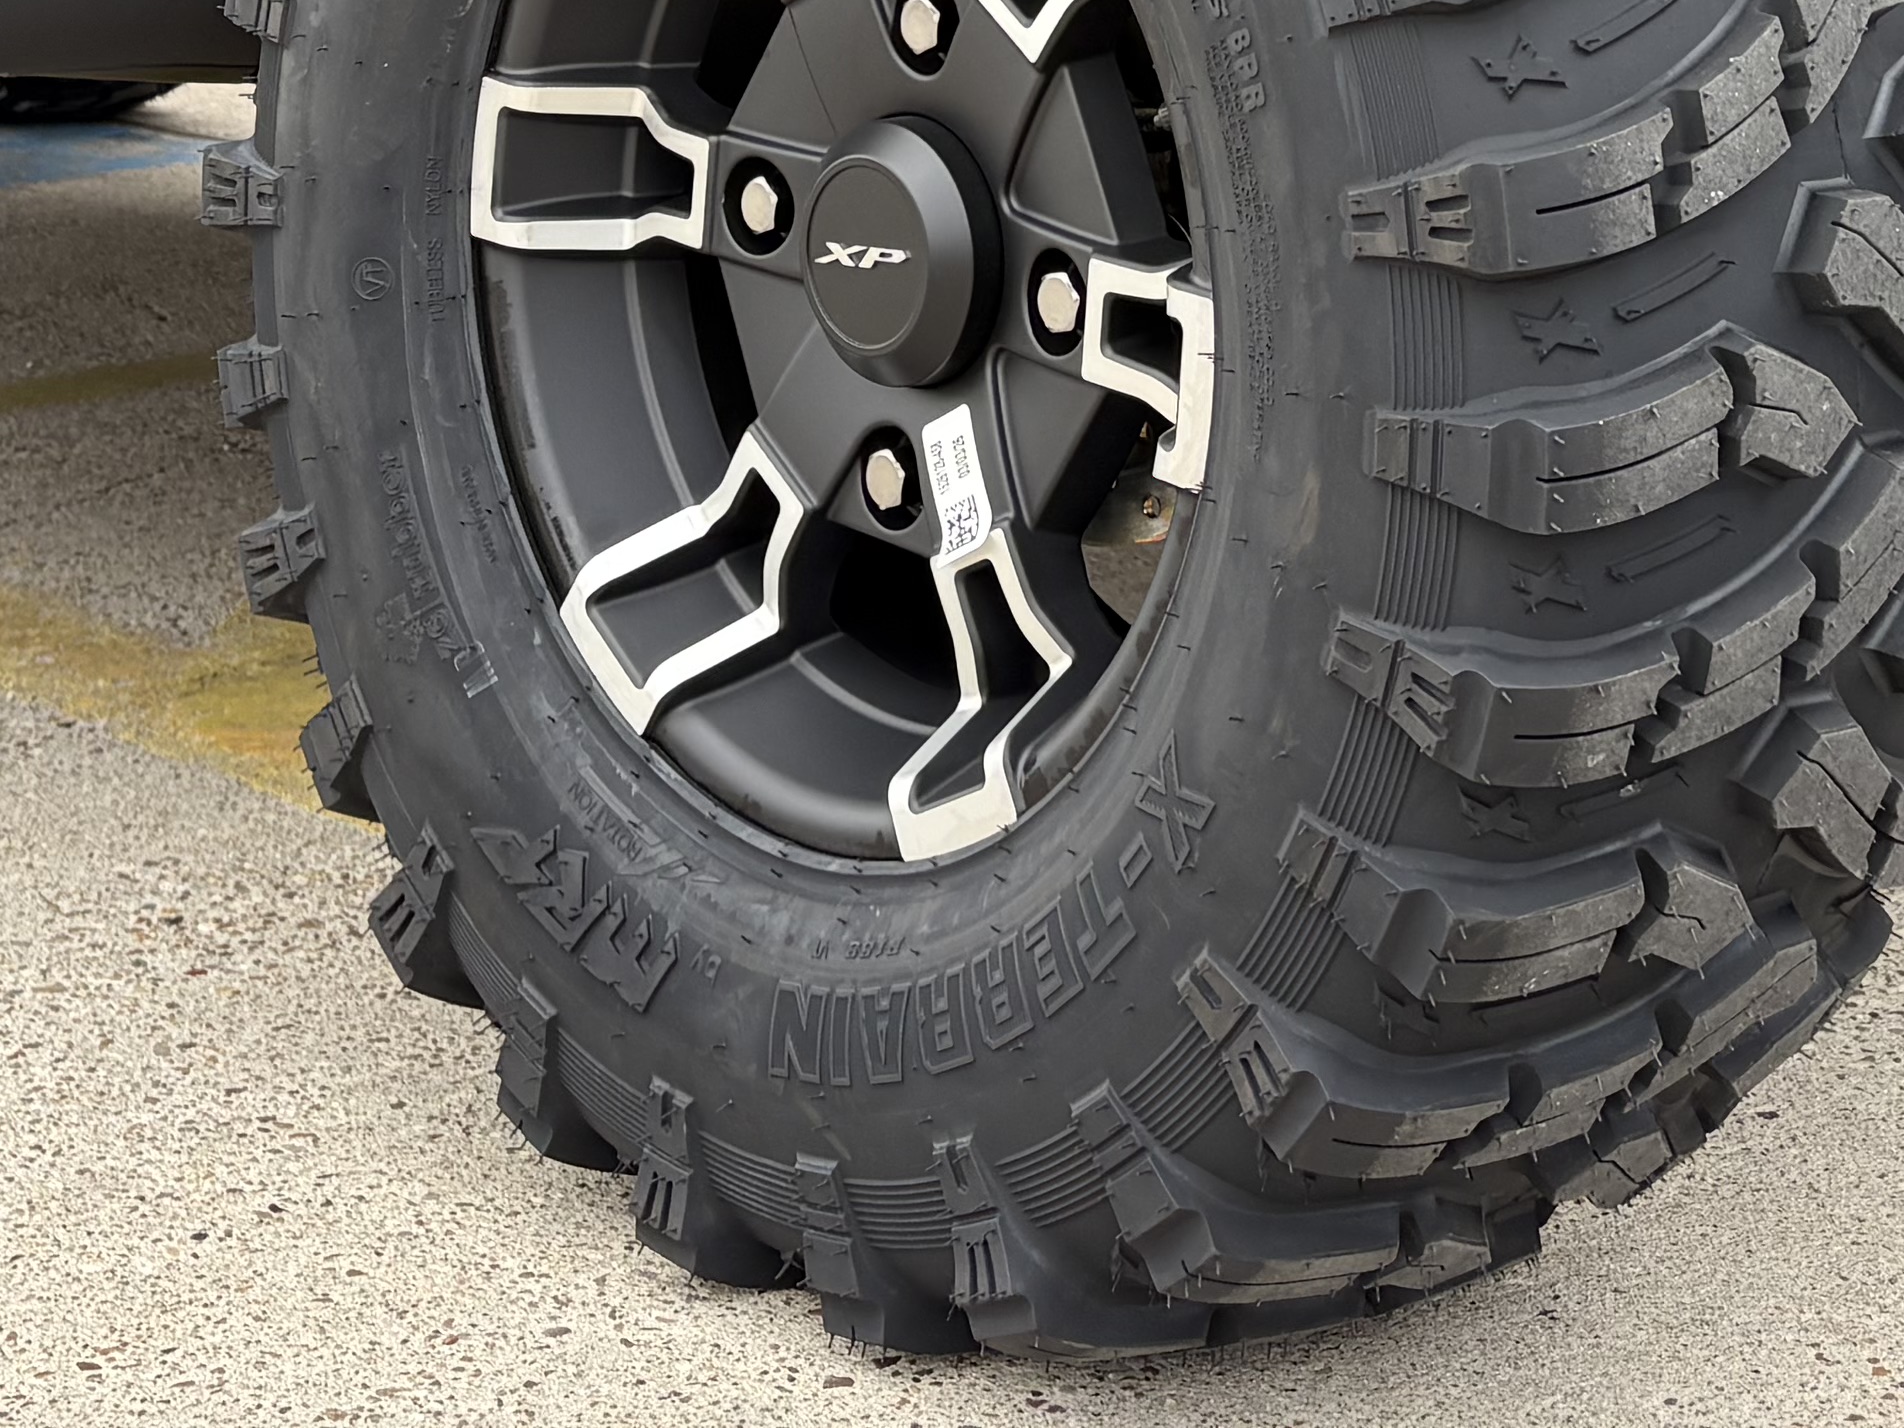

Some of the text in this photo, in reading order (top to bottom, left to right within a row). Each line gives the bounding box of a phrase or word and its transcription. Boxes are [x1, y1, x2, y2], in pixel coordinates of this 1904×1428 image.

[423, 151, 450, 322] TUBELESS NYLON
[814, 241, 910, 269] XP
[566, 775, 644, 864] ROTATION
[769, 733, 1216, 1087] X-TERRAIN
